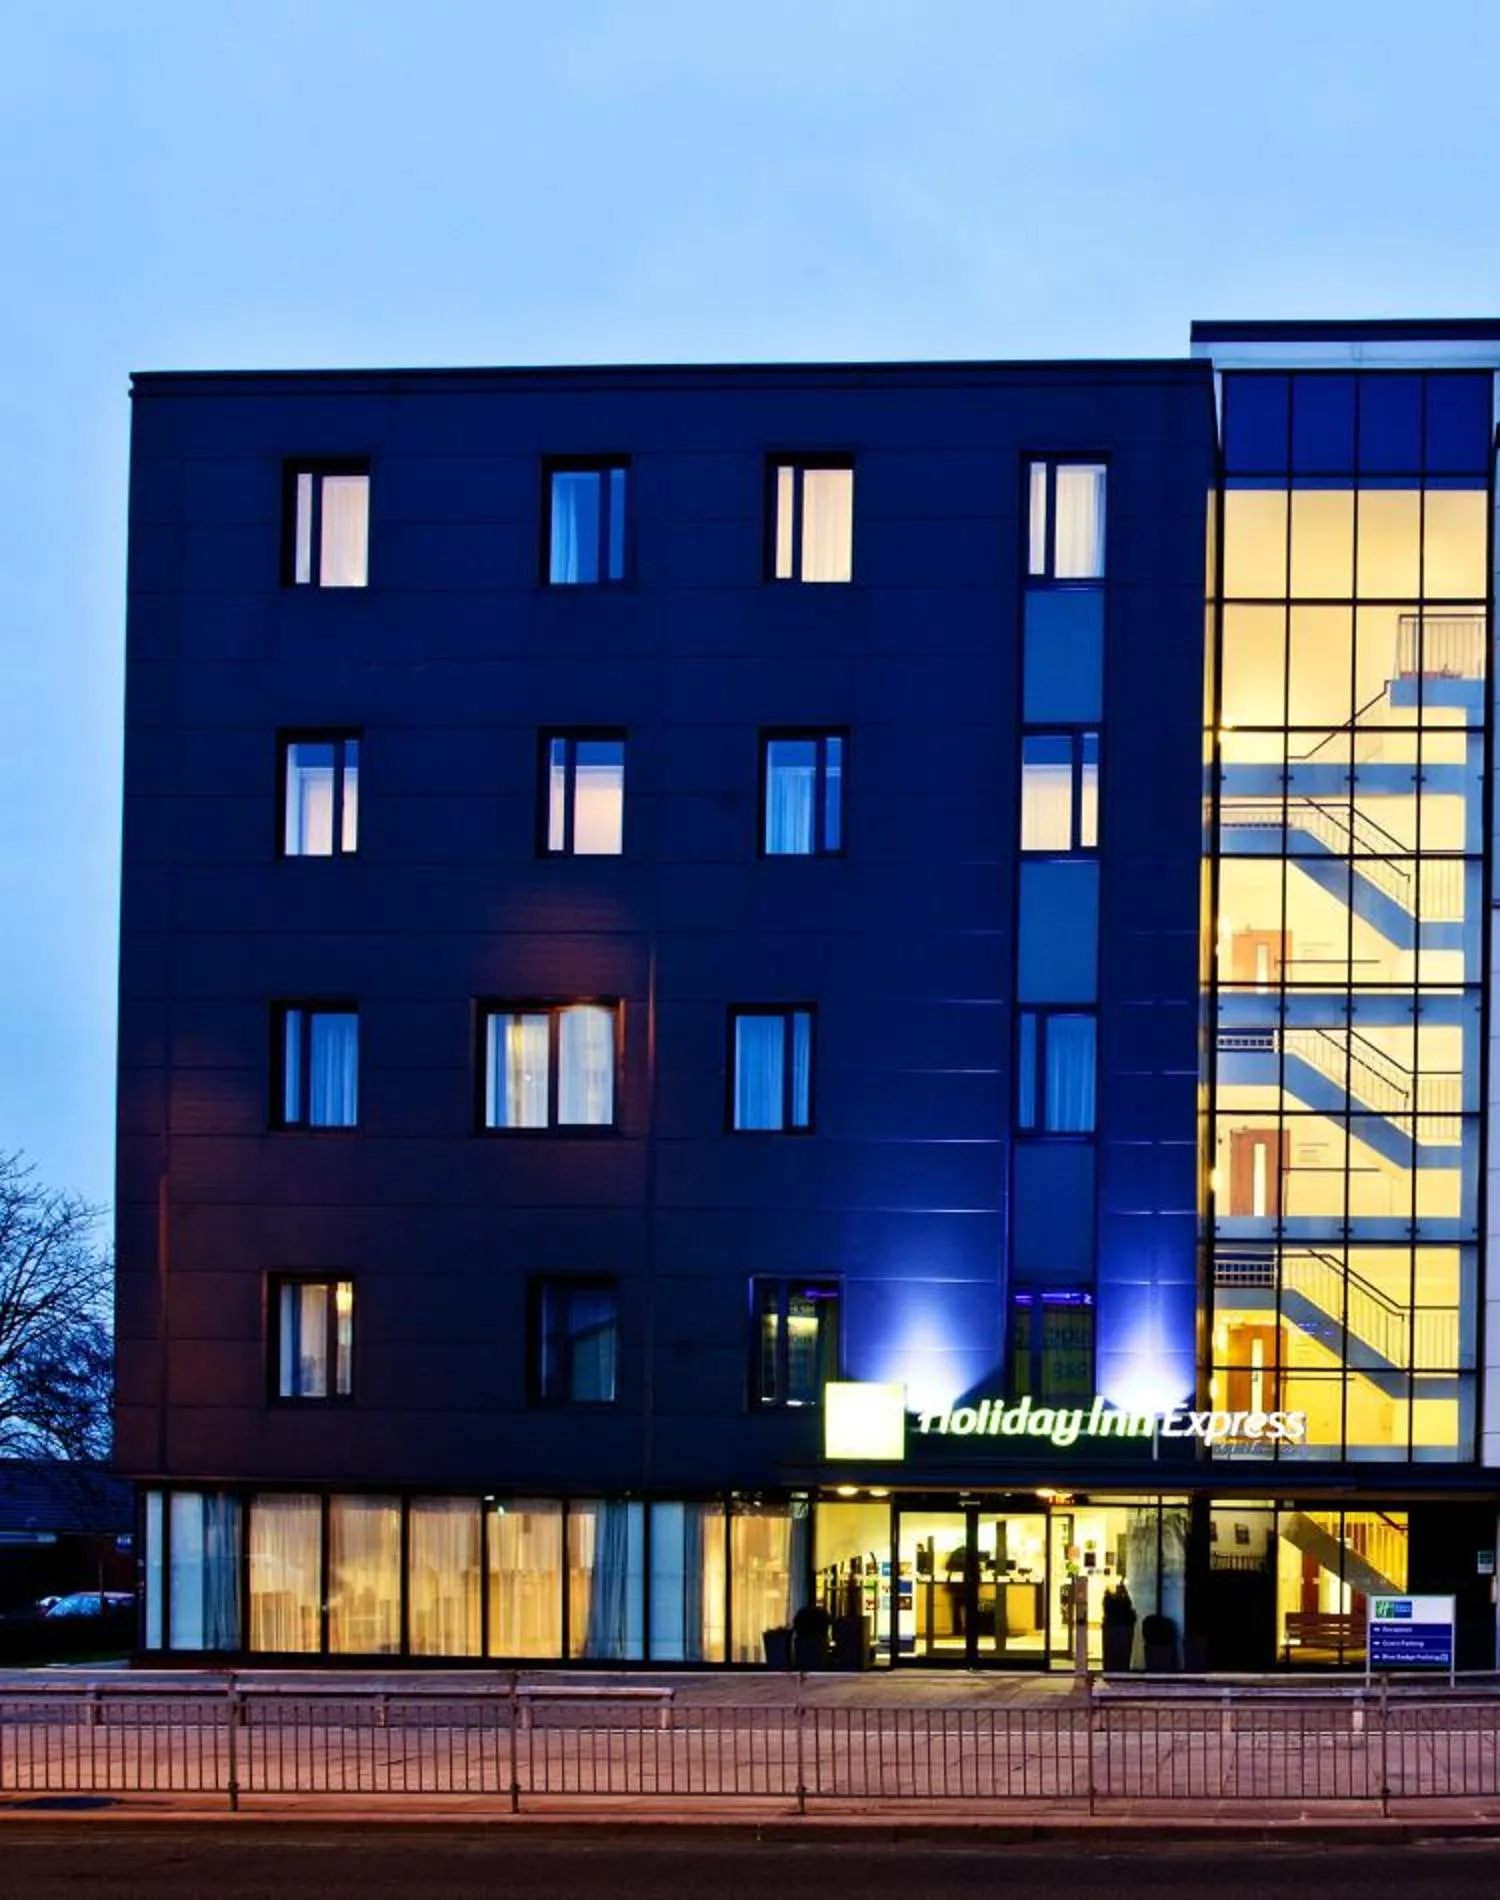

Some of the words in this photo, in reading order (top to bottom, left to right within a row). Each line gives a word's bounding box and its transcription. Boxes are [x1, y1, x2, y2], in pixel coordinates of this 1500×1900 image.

[917, 1395, 1083, 1446] Holiday
[1087, 1395, 1155, 1437] Inn
[1161, 1402, 1306, 1447] Express
